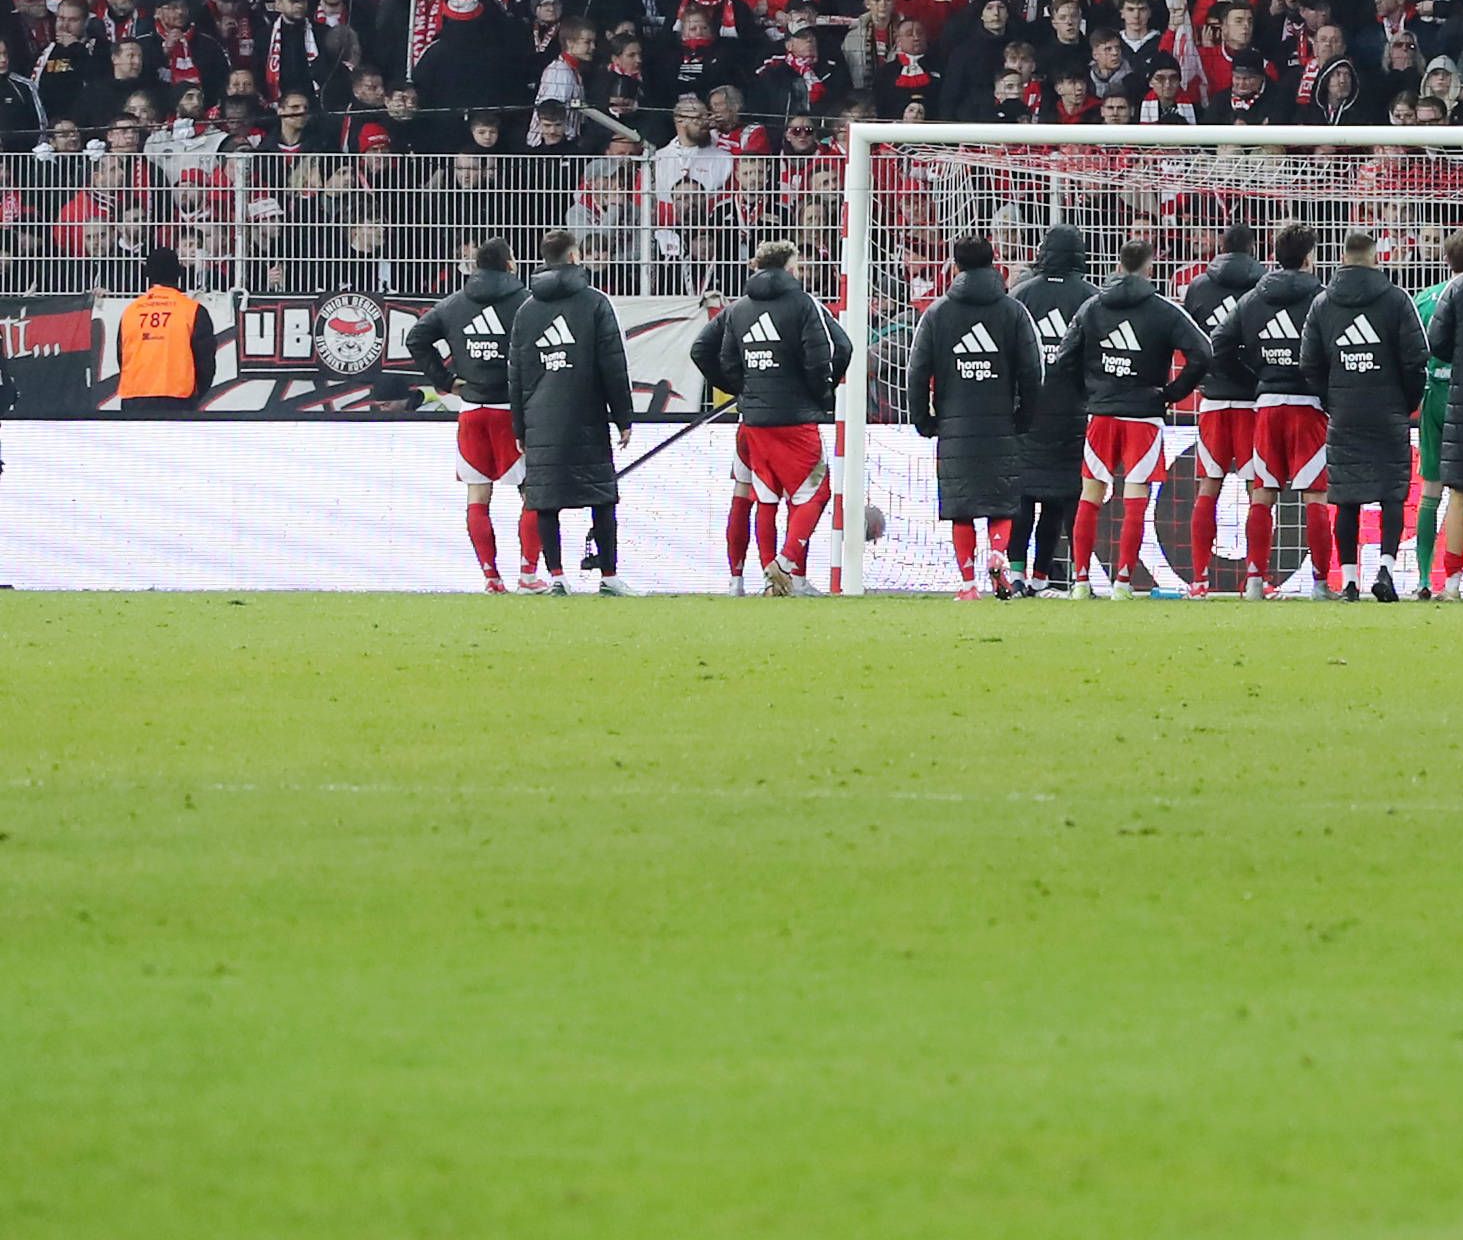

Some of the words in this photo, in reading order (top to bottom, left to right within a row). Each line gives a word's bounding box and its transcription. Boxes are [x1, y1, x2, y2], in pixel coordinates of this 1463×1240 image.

[139, 312, 172, 328] 787
[466, 339, 498, 350] home
[744, 349, 773, 360] home
[1102, 352, 1132, 366] home
[1340, 351, 1374, 362] home
[956, 359, 991, 371] home
